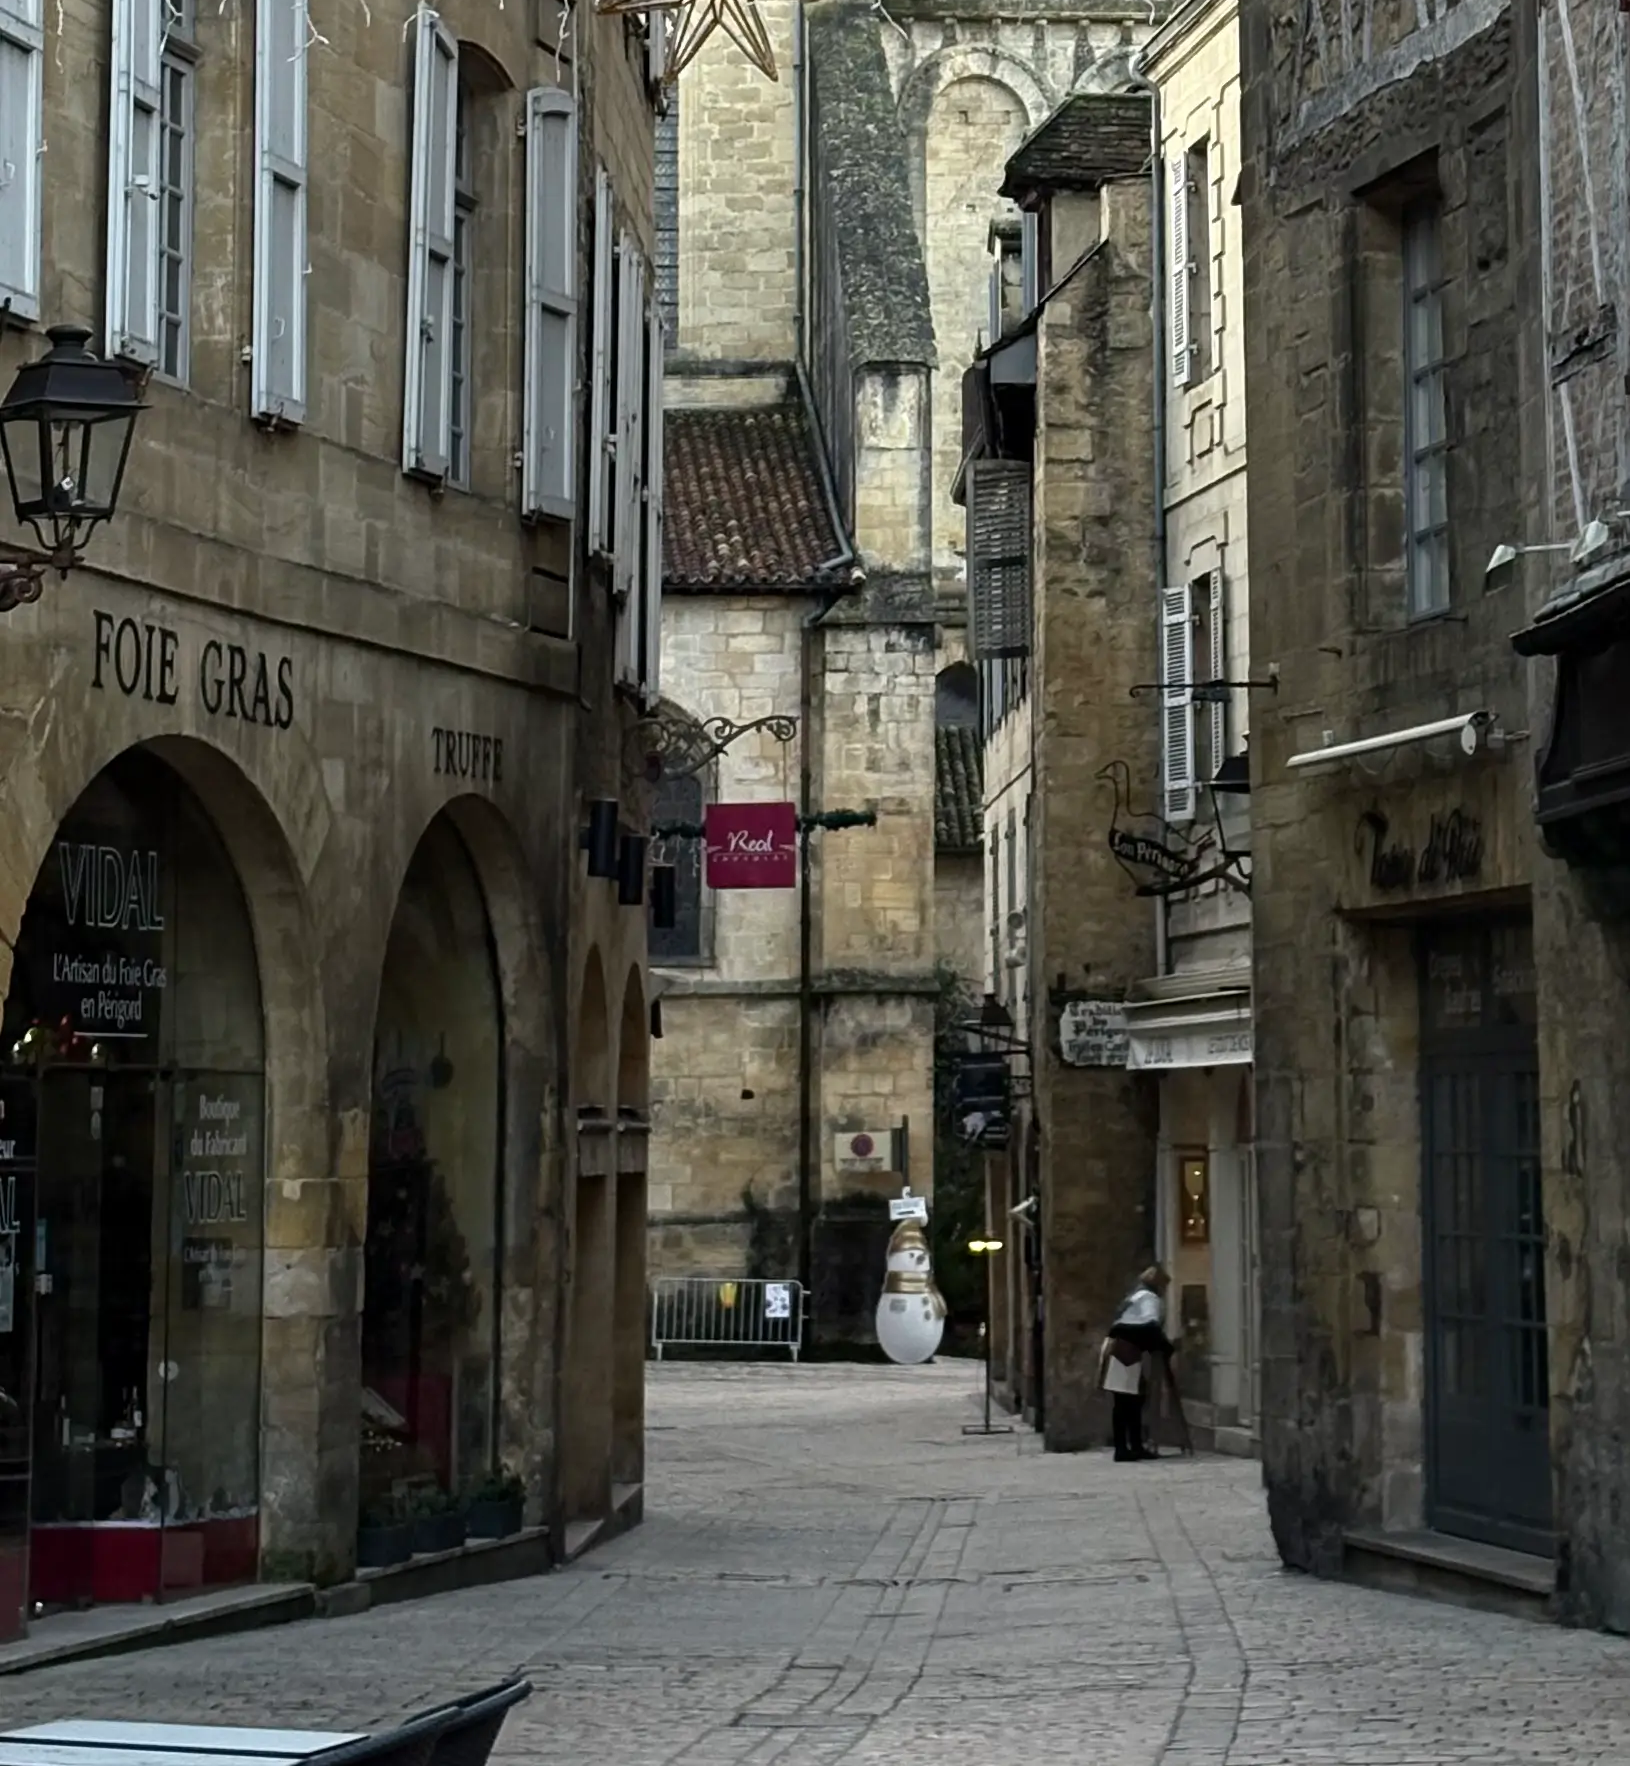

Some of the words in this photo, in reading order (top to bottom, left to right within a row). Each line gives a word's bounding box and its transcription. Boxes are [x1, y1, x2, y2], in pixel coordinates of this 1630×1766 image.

[92, 609, 180, 706] FOIE
[200, 639, 294, 731] GRAS
[432, 726, 504, 782] TRUFFE
[58, 841, 166, 932] VIDAL
[102, 955, 118, 985] du
[119, 957, 142, 986] Foie
[143, 959, 167, 988] Gras
[81, 996, 96, 1019] en
[97, 990, 143, 1030] Périgord
[200, 1094, 240, 1128] Boutique
[190, 1131, 203, 1156] du
[184, 1170, 247, 1225] VIDAL
